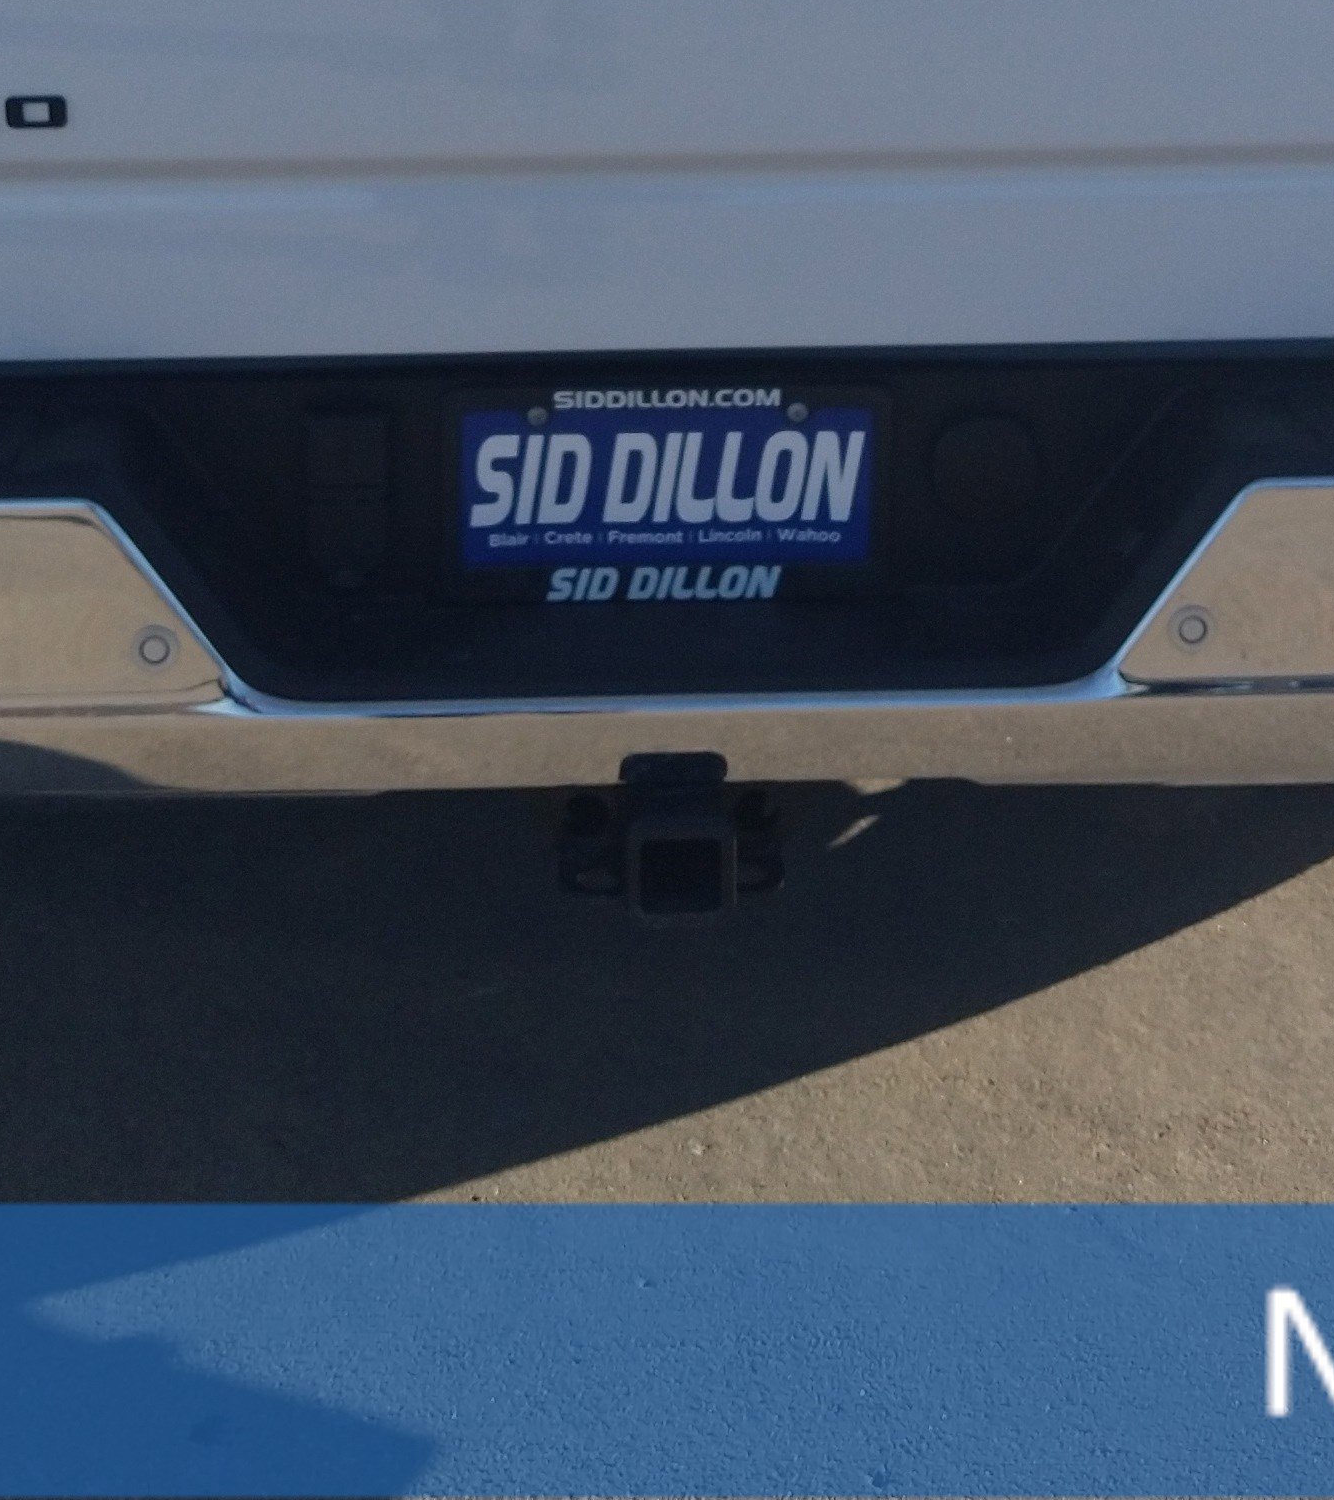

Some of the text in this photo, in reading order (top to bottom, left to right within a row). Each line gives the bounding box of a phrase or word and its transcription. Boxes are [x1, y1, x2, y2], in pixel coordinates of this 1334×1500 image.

[553, 388, 781, 410] SIDDILLON.COM
[470, 430, 866, 528] SID DILLON
[488, 527, 842, 548] Blair Crete Fremont Lincoln Wahoo
[546, 565, 782, 601] SID DILLON
